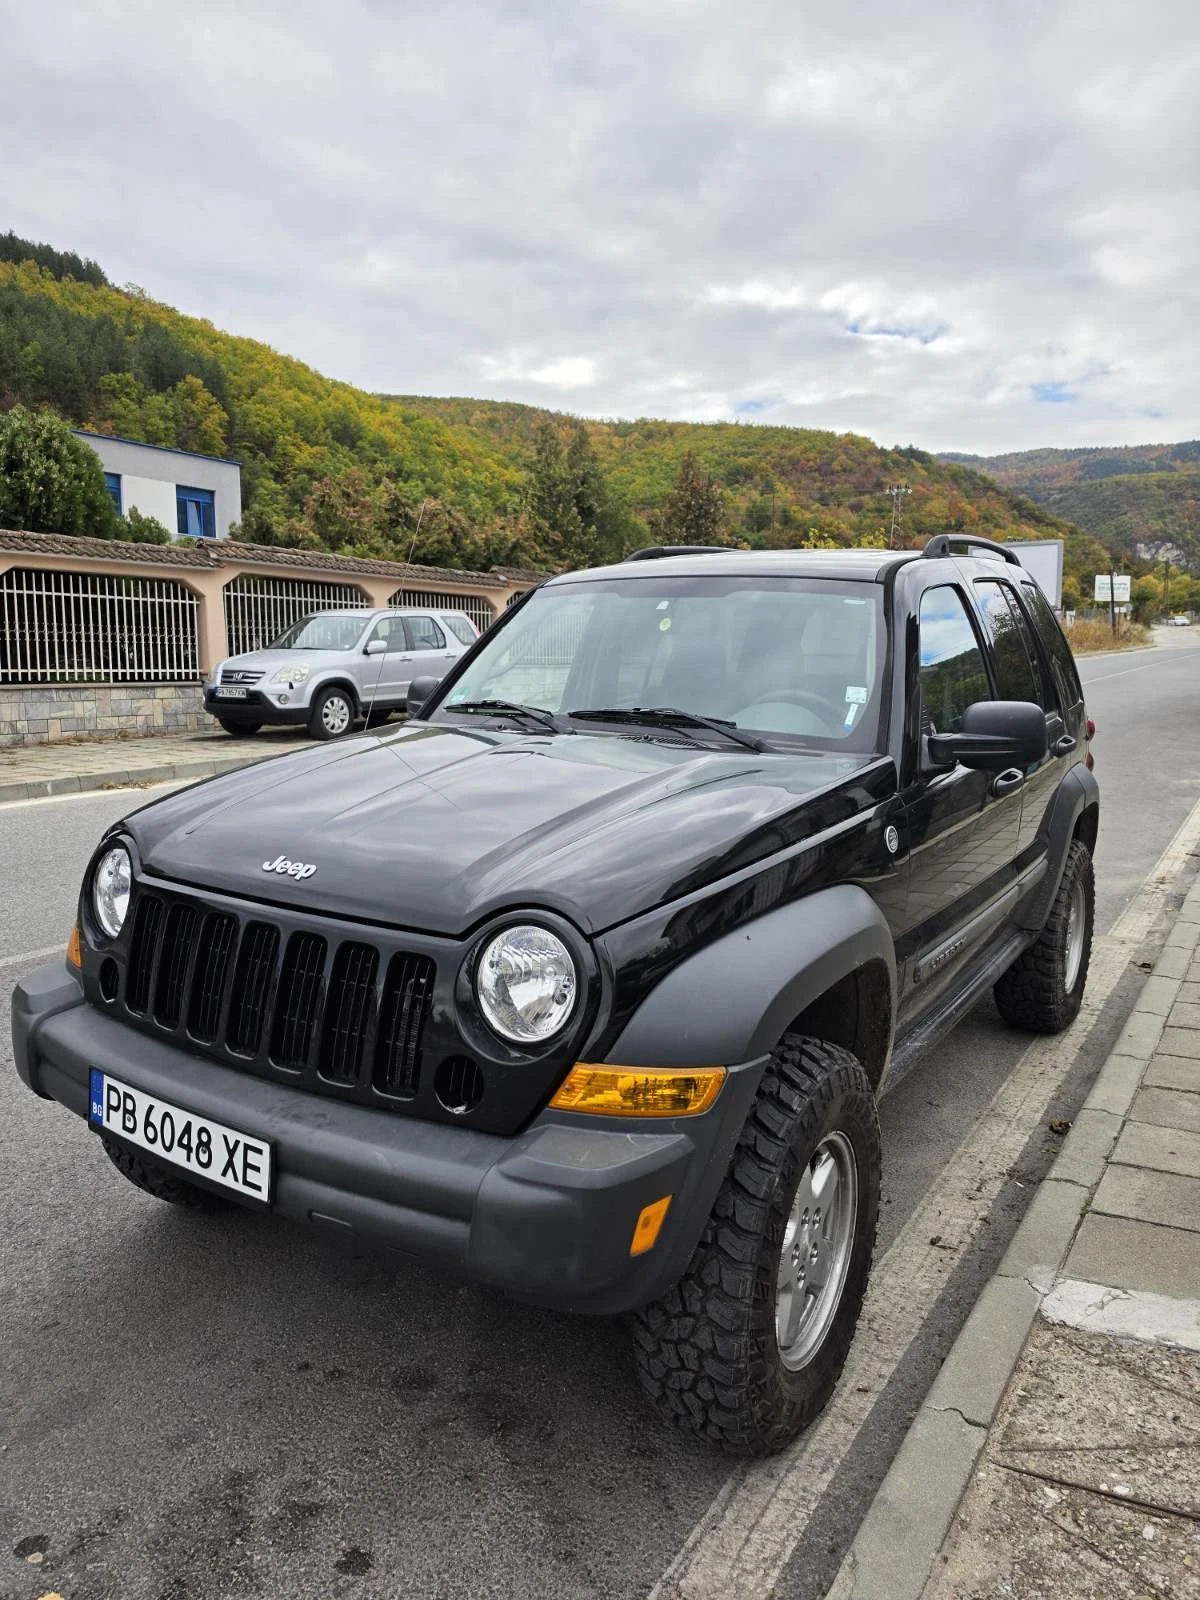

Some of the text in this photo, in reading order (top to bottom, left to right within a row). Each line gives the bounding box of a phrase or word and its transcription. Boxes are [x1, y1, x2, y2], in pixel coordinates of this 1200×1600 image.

[262, 855, 317, 881] Jeep
[92, 1102, 102, 1117] BG
[106, 1083, 263, 1192] PB 6048 XE
